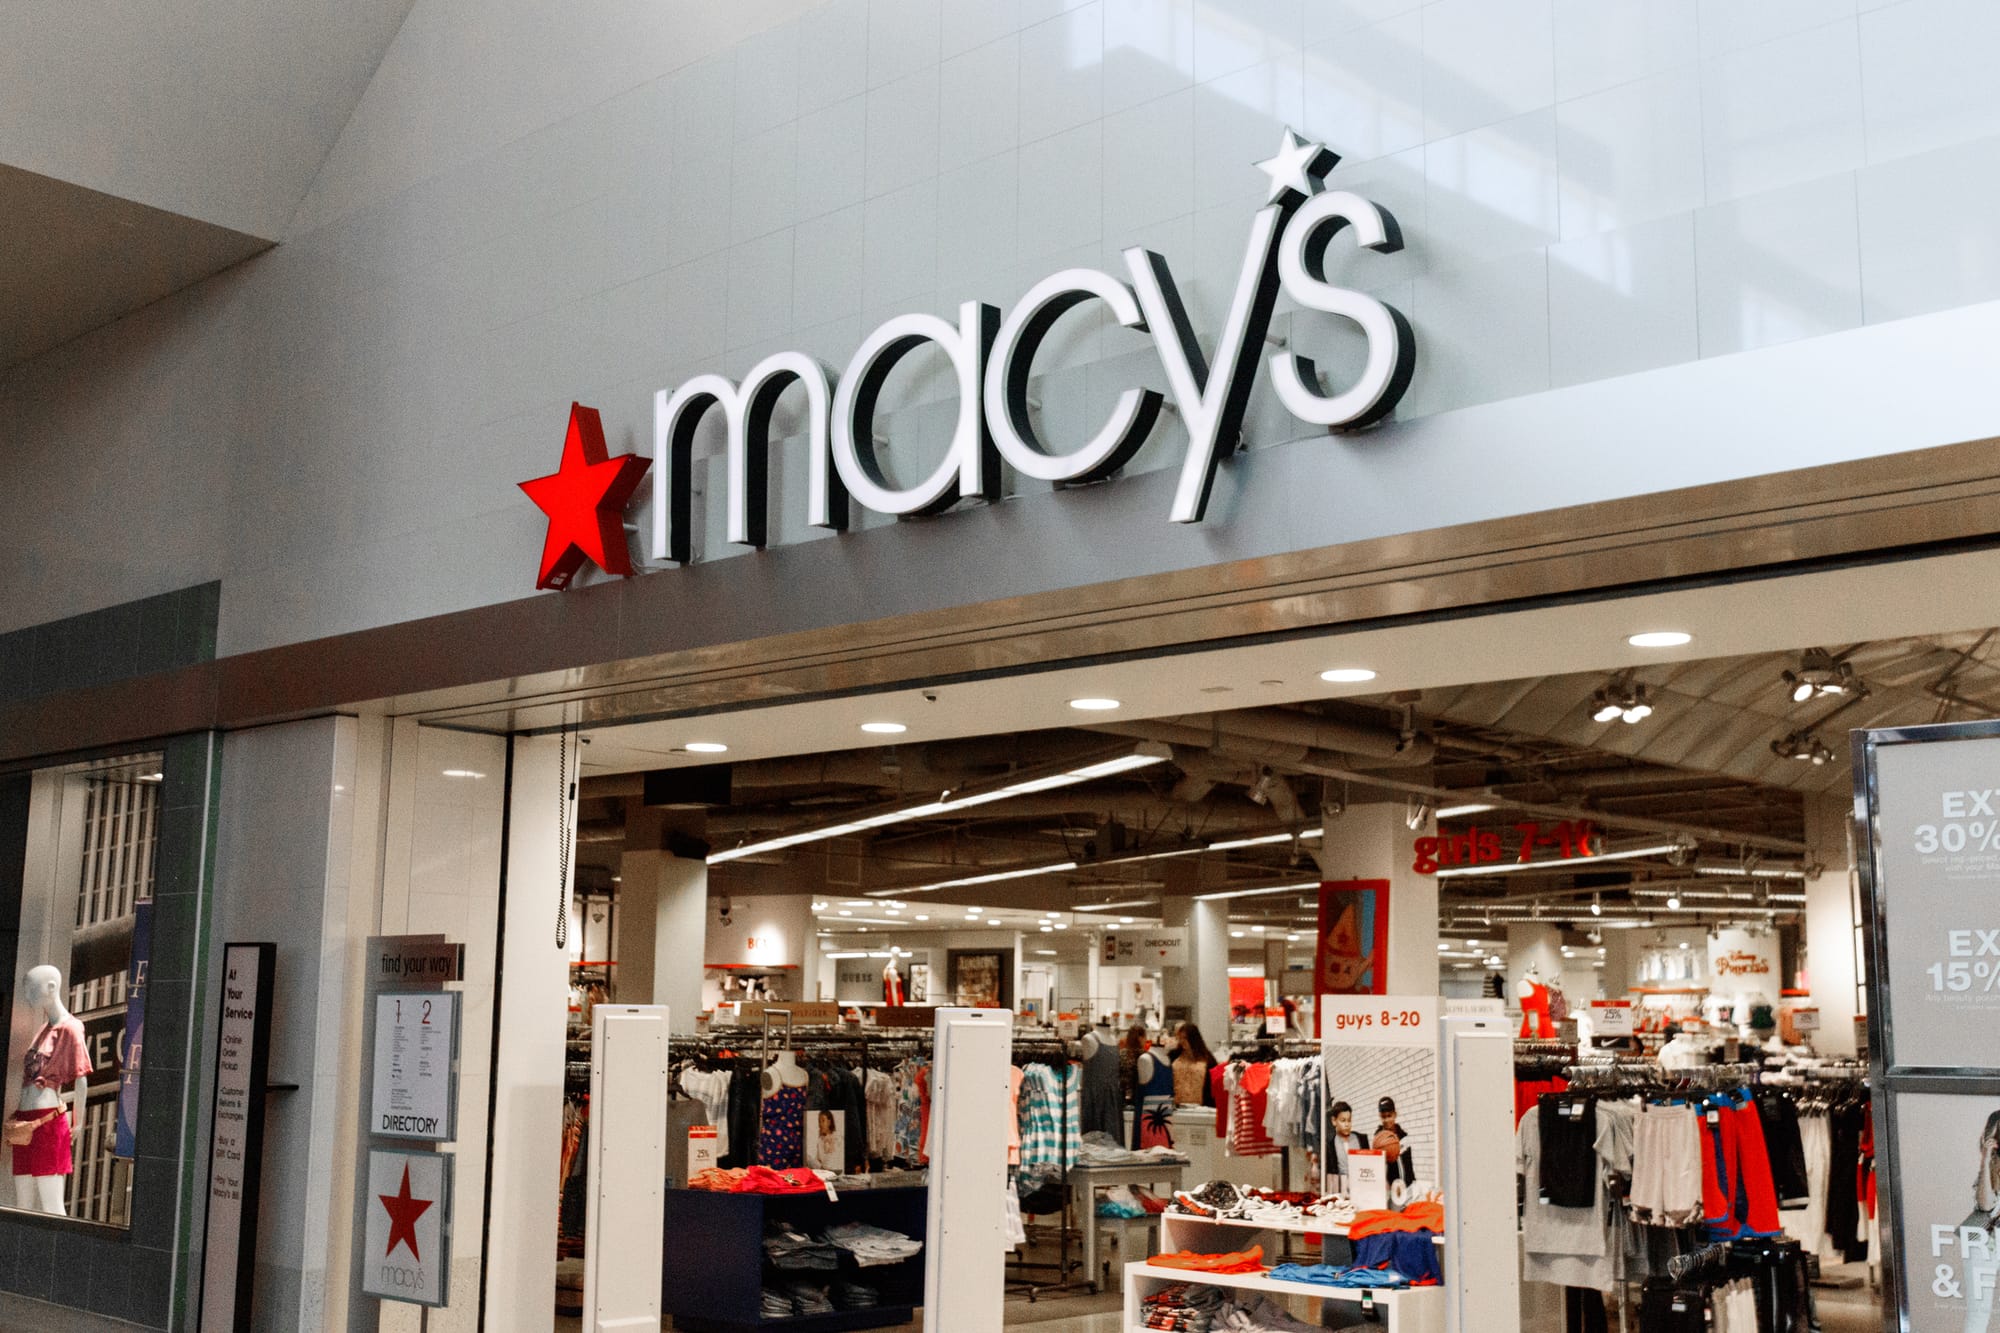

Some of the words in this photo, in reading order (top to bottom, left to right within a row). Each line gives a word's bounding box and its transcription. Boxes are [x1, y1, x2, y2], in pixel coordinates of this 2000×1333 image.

[1914, 820, 2000, 854] 30%
[1412, 825, 1501, 875] girls
[1144, 938, 1181, 948] CHECKOUT
[228, 968, 237, 981] At
[382, 953, 401, 974] find
[403, 957, 428, 977] your
[430, 956, 452, 978] way
[227, 987, 243, 1000] Your
[225, 1006, 254, 1020] Service
[421, 1000, 432, 1025] 2
[1336, 1013, 1373, 1030] guys
[1381, 1011, 1421, 1027] 8-20
[1603, 1008, 1622, 1020] 25%
[383, 1114, 439, 1135] DIRECTORY
[1932, 1264, 1963, 1299] &
